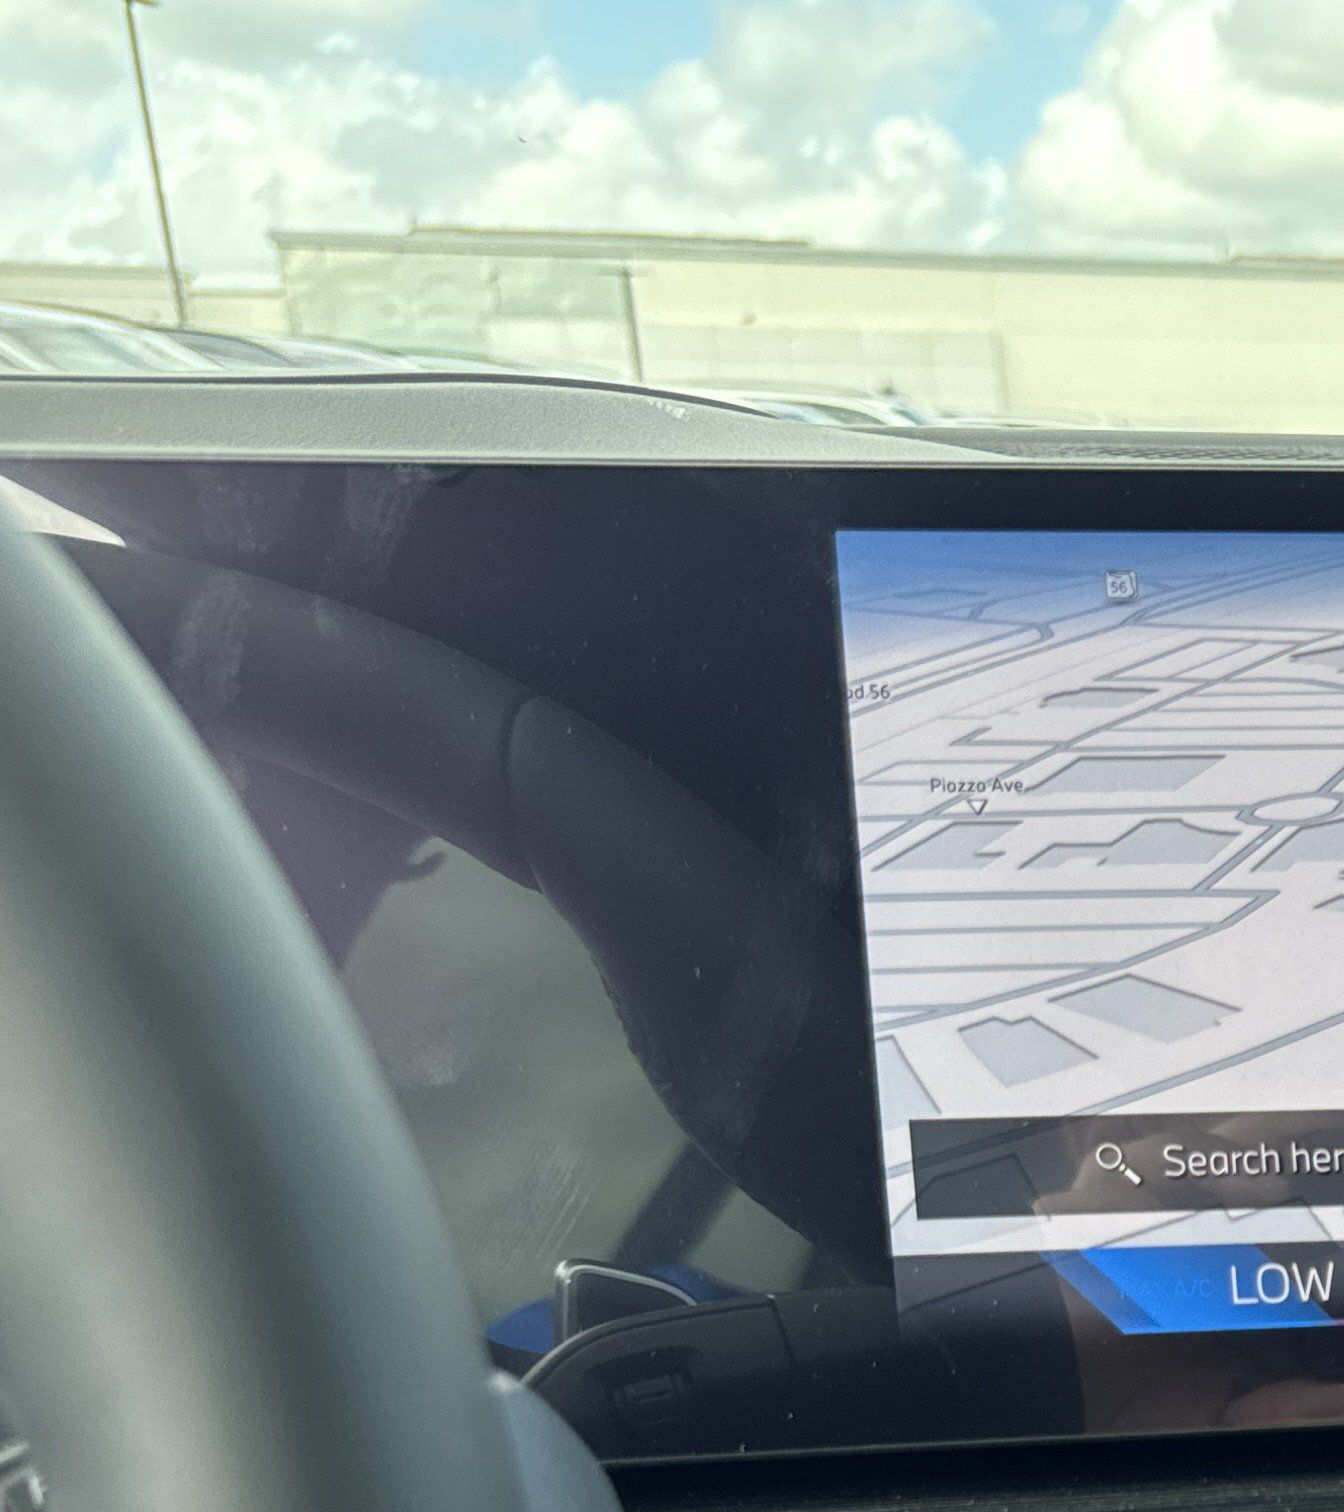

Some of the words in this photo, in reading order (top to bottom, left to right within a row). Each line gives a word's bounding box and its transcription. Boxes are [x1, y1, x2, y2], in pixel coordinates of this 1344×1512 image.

[1111, 581, 1128, 594] 56
[991, 776, 1024, 793] Ave
[1163, 1142, 1280, 1178] Search
[1230, 1260, 1335, 1305] LOW
